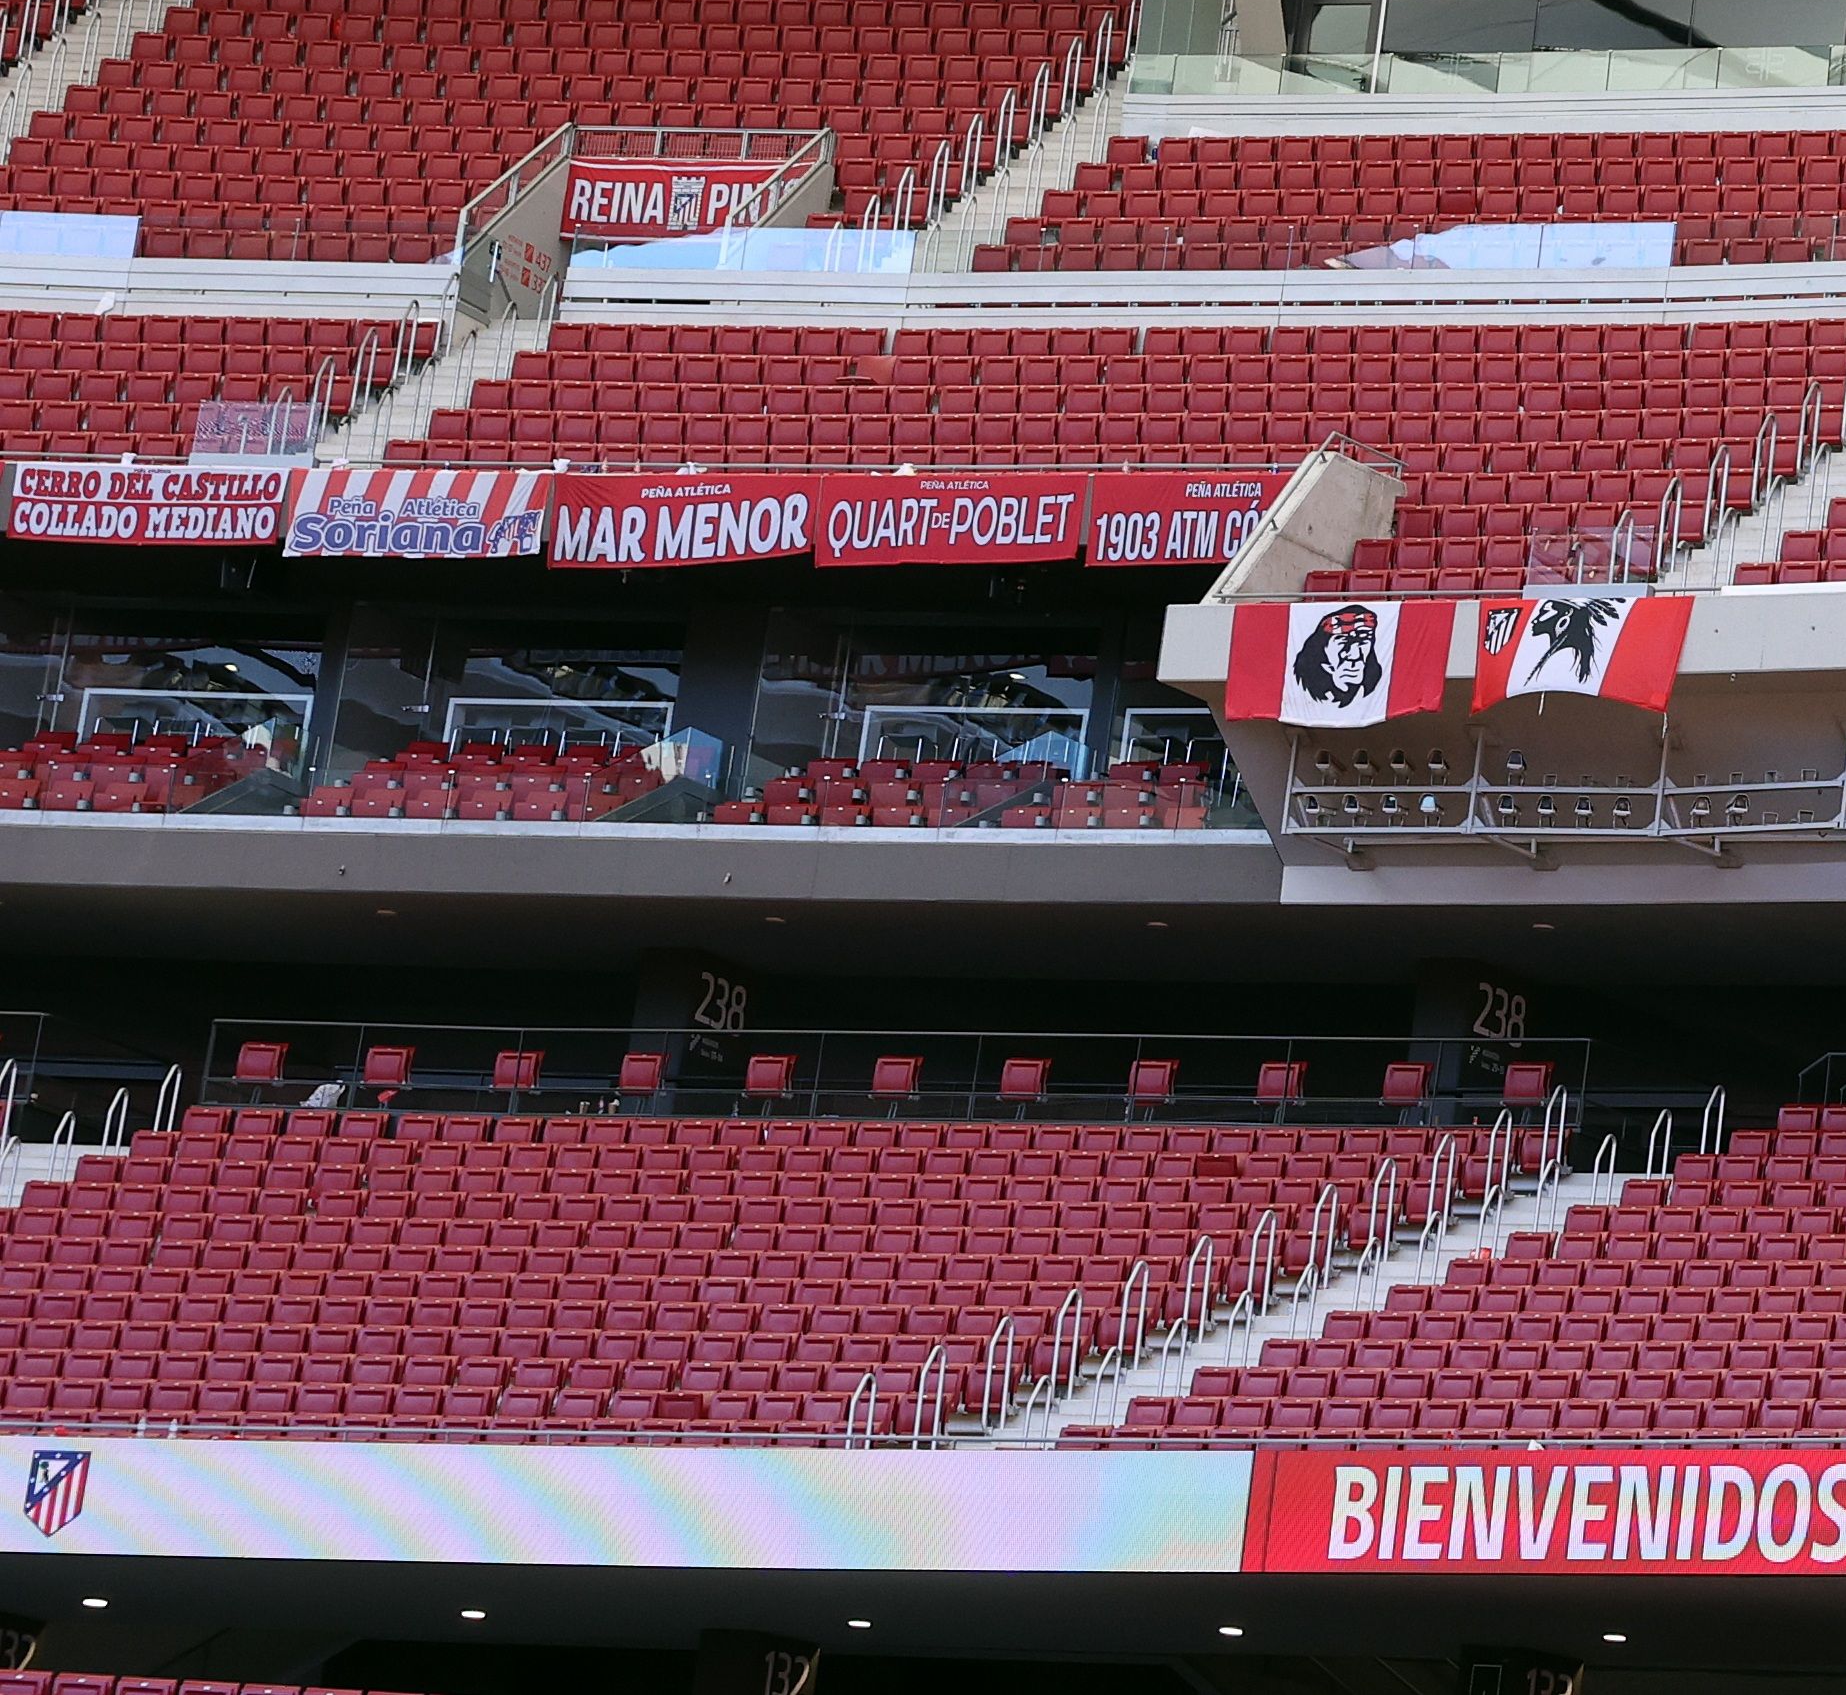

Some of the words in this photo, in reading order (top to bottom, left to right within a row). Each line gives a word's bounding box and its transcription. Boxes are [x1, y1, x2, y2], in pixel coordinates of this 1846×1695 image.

[569, 178, 665, 225] REINA
[20, 468, 101, 499] CERRO
[107, 472, 153, 501] DEL
[162, 472, 282, 501] CASTILLO
[328, 496, 375, 516] Peña
[402, 495, 479, 518] Atlética
[641, 484, 672, 499] PEÑA
[674, 482, 732, 498] ATLÉTICA
[920, 480, 945, 491] PEÑA
[946, 480, 989, 491] ATLÉTICA
[1185, 481, 1211, 498] PEÑA
[1213, 481, 1262, 498] ATLÉTICA
[13, 501, 139, 539] COLLADO
[144, 505, 277, 540] MEDIANO
[290, 509, 485, 554] Soriana
[553, 505, 648, 563] MAR
[654, 493, 809, 562] MENOR
[827, 498, 939, 558] QUART
[931, 512, 950, 529] DE
[949, 494, 1075, 546] POBLET
[1096, 511, 1161, 562] 1903
[1164, 510, 1219, 559] ATM
[1222, 499, 1268, 560] CÓ
[694, 971, 747, 1037] 238
[1473, 982, 1527, 1048] 238
